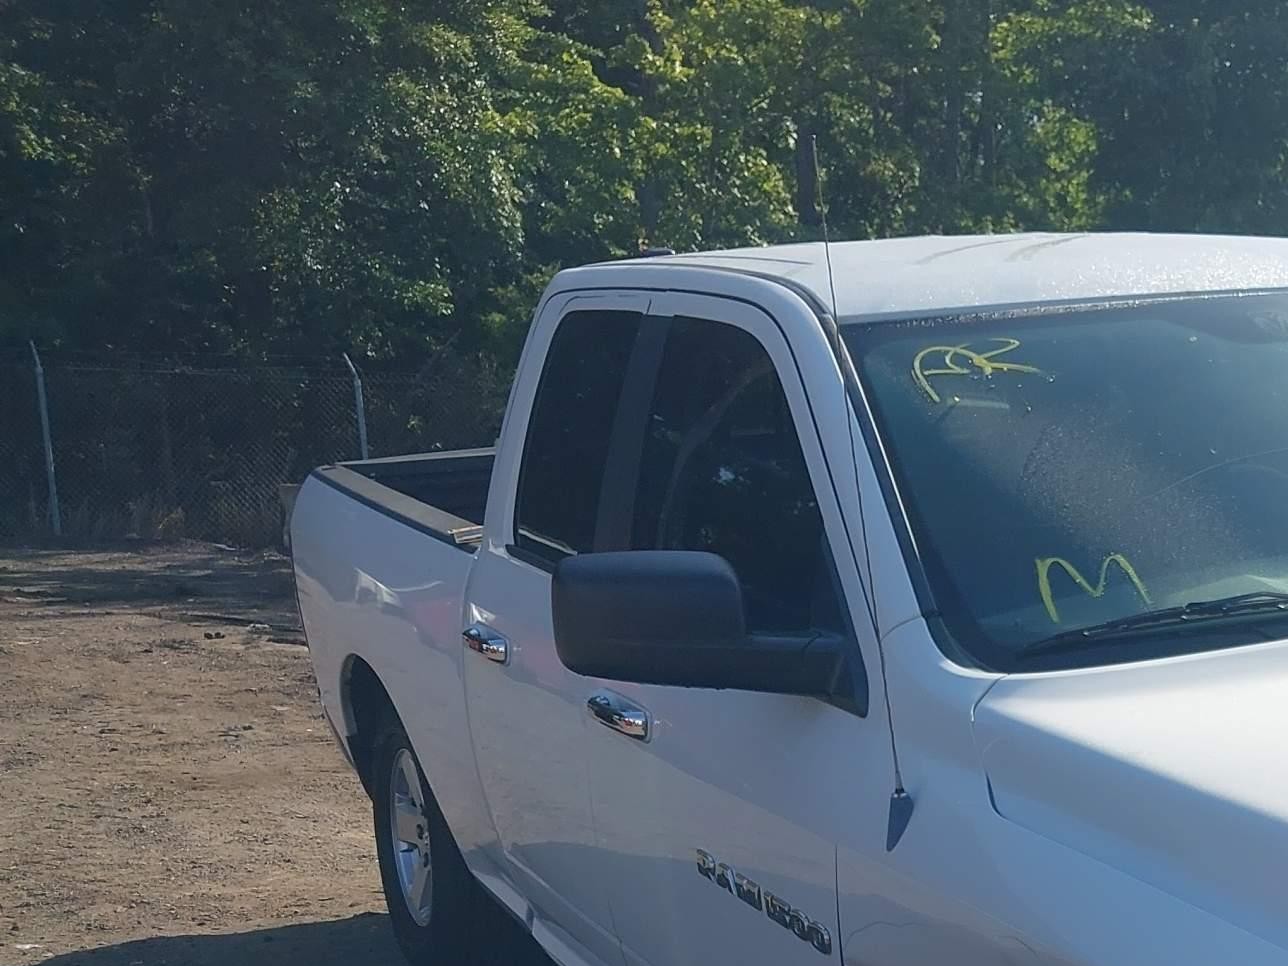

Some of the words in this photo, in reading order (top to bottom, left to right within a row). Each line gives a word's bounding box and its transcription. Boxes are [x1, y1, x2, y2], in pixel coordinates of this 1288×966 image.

[1035, 553, 1151, 624] M
[697, 848, 763, 912] RAM
[763, 890, 832, 955] 1500
